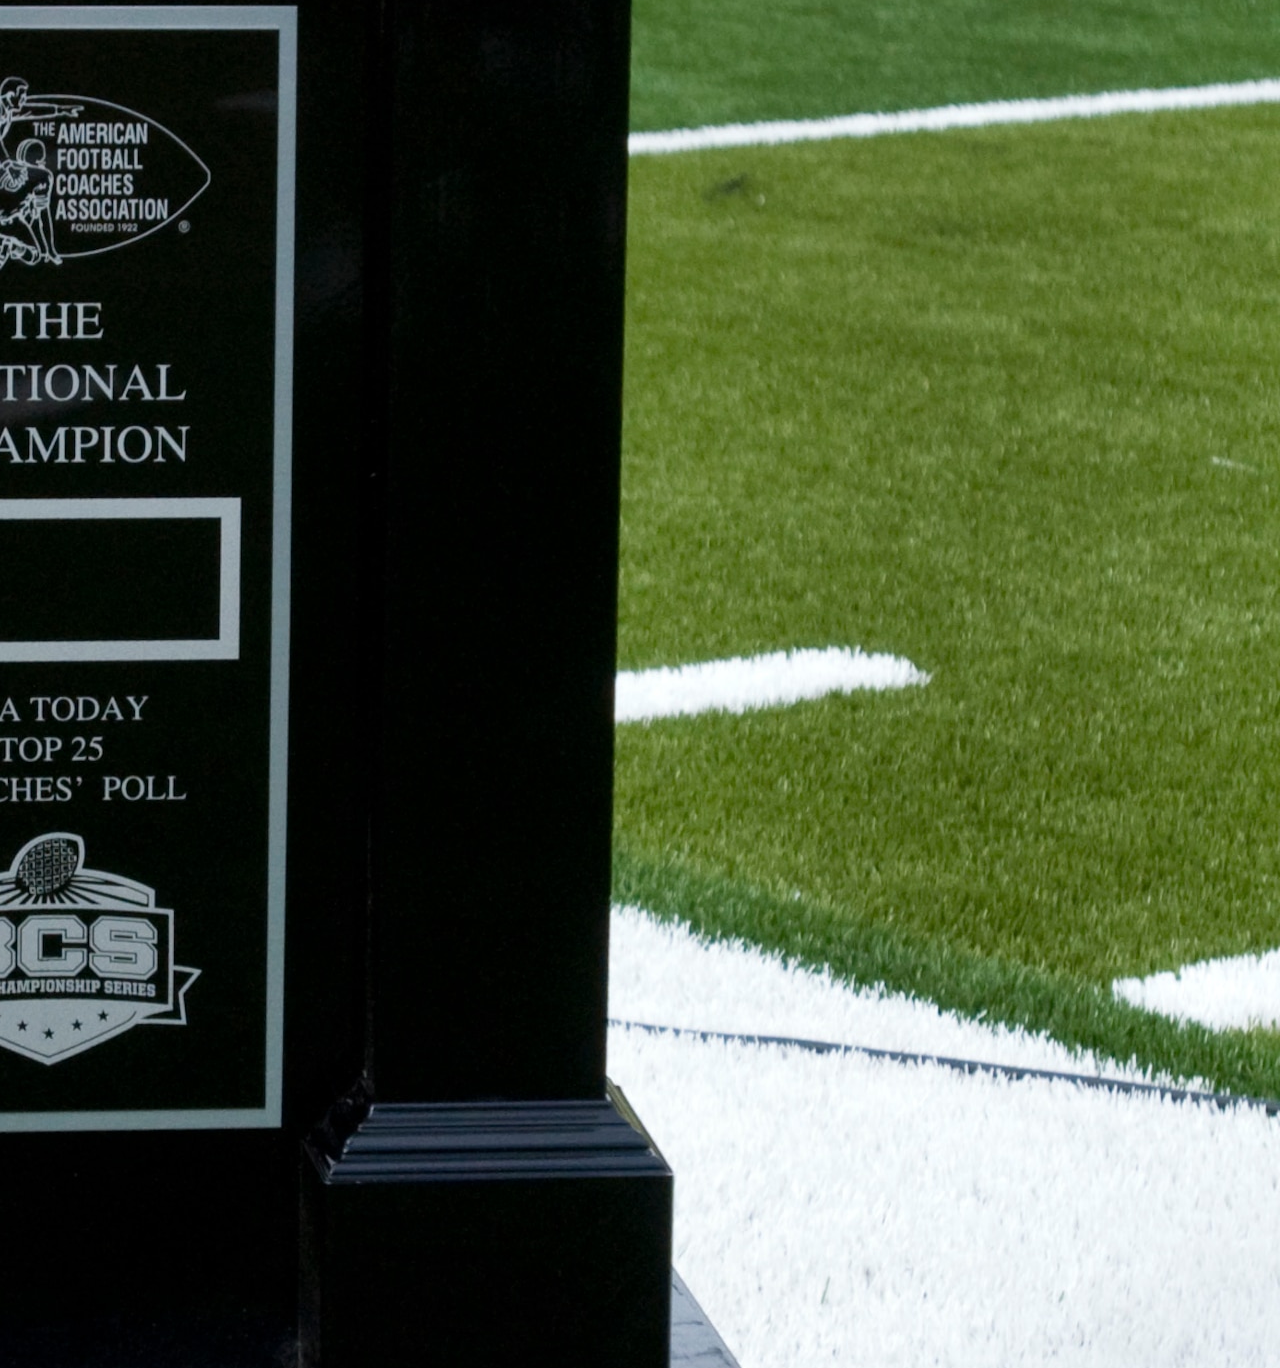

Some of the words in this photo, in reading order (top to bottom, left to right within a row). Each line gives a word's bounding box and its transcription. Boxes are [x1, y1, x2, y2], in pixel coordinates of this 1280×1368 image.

[32, 121, 56, 136] THE
[57, 122, 148, 144] AMERICAN
[56, 148, 143, 170] FOOTBALL
[56, 174, 133, 196] COACHES
[55, 198, 168, 220] ASSOCIATION
[71, 223, 115, 233] FOUNDED
[117, 223, 138, 233] 1922
[4, 302, 104, 340] THE
[29, 695, 149, 722] TODAY
[71, 736, 104, 761] 25
[102, 775, 187, 801] POLL
[104, 981, 156, 998] SERIES
